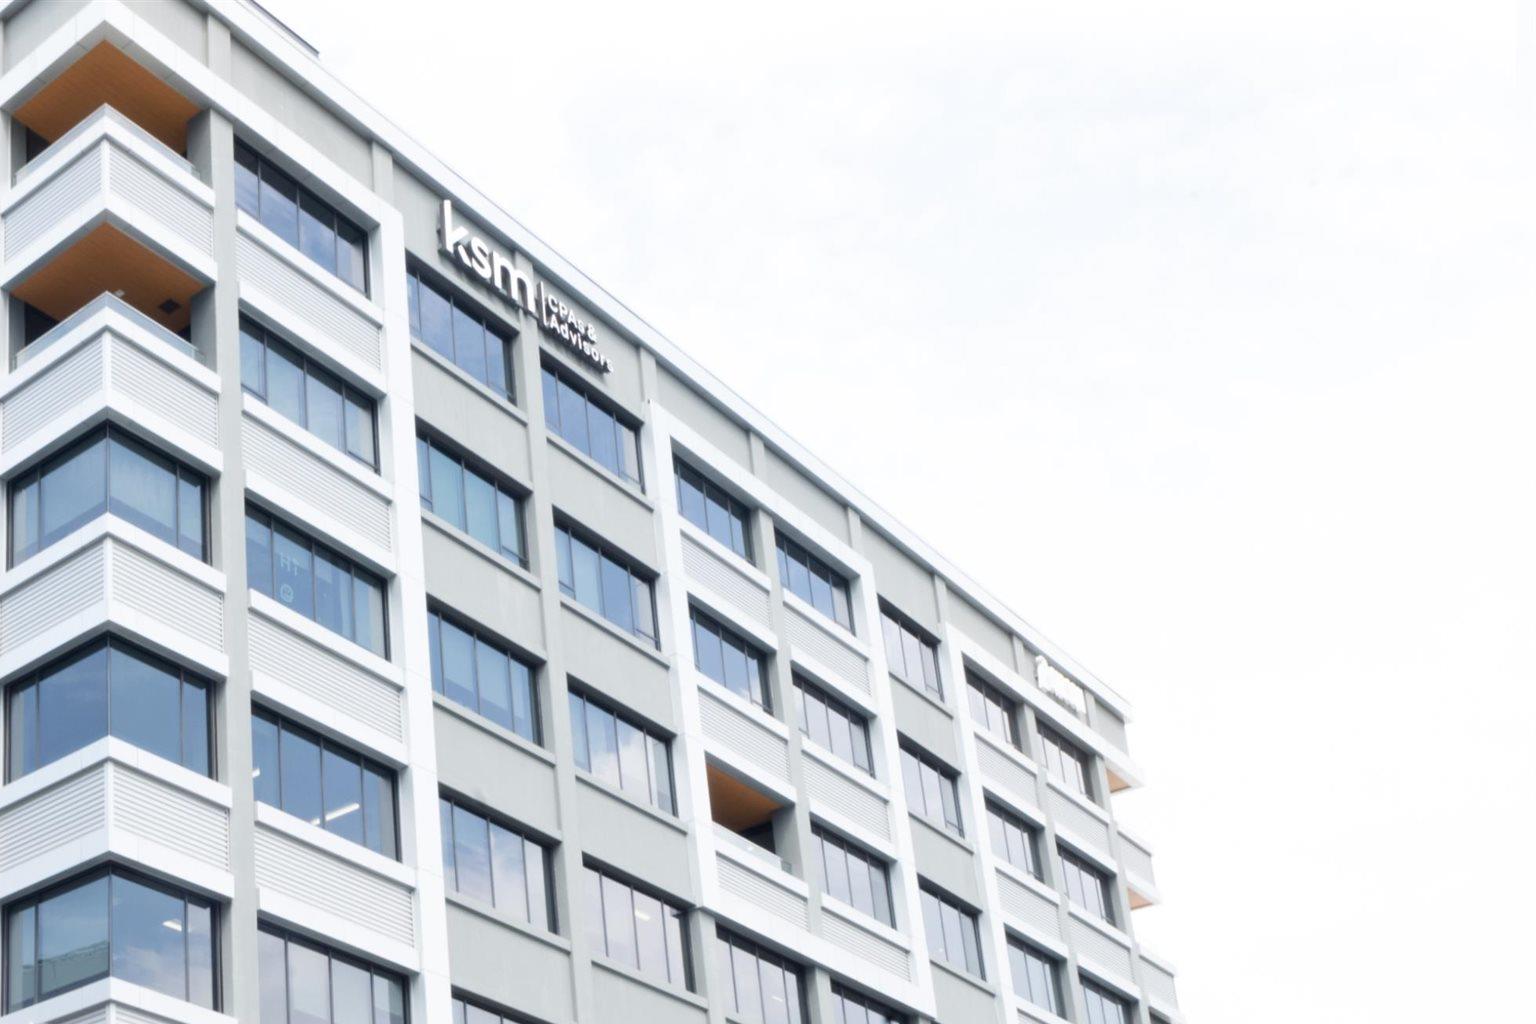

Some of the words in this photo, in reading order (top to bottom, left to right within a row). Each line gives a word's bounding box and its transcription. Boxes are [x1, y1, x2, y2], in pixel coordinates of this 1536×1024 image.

[443, 199, 536, 313] ksm
[548, 293, 586, 333] CPAs
[586, 324, 599, 341] &
[549, 316, 613, 372] Advisors
